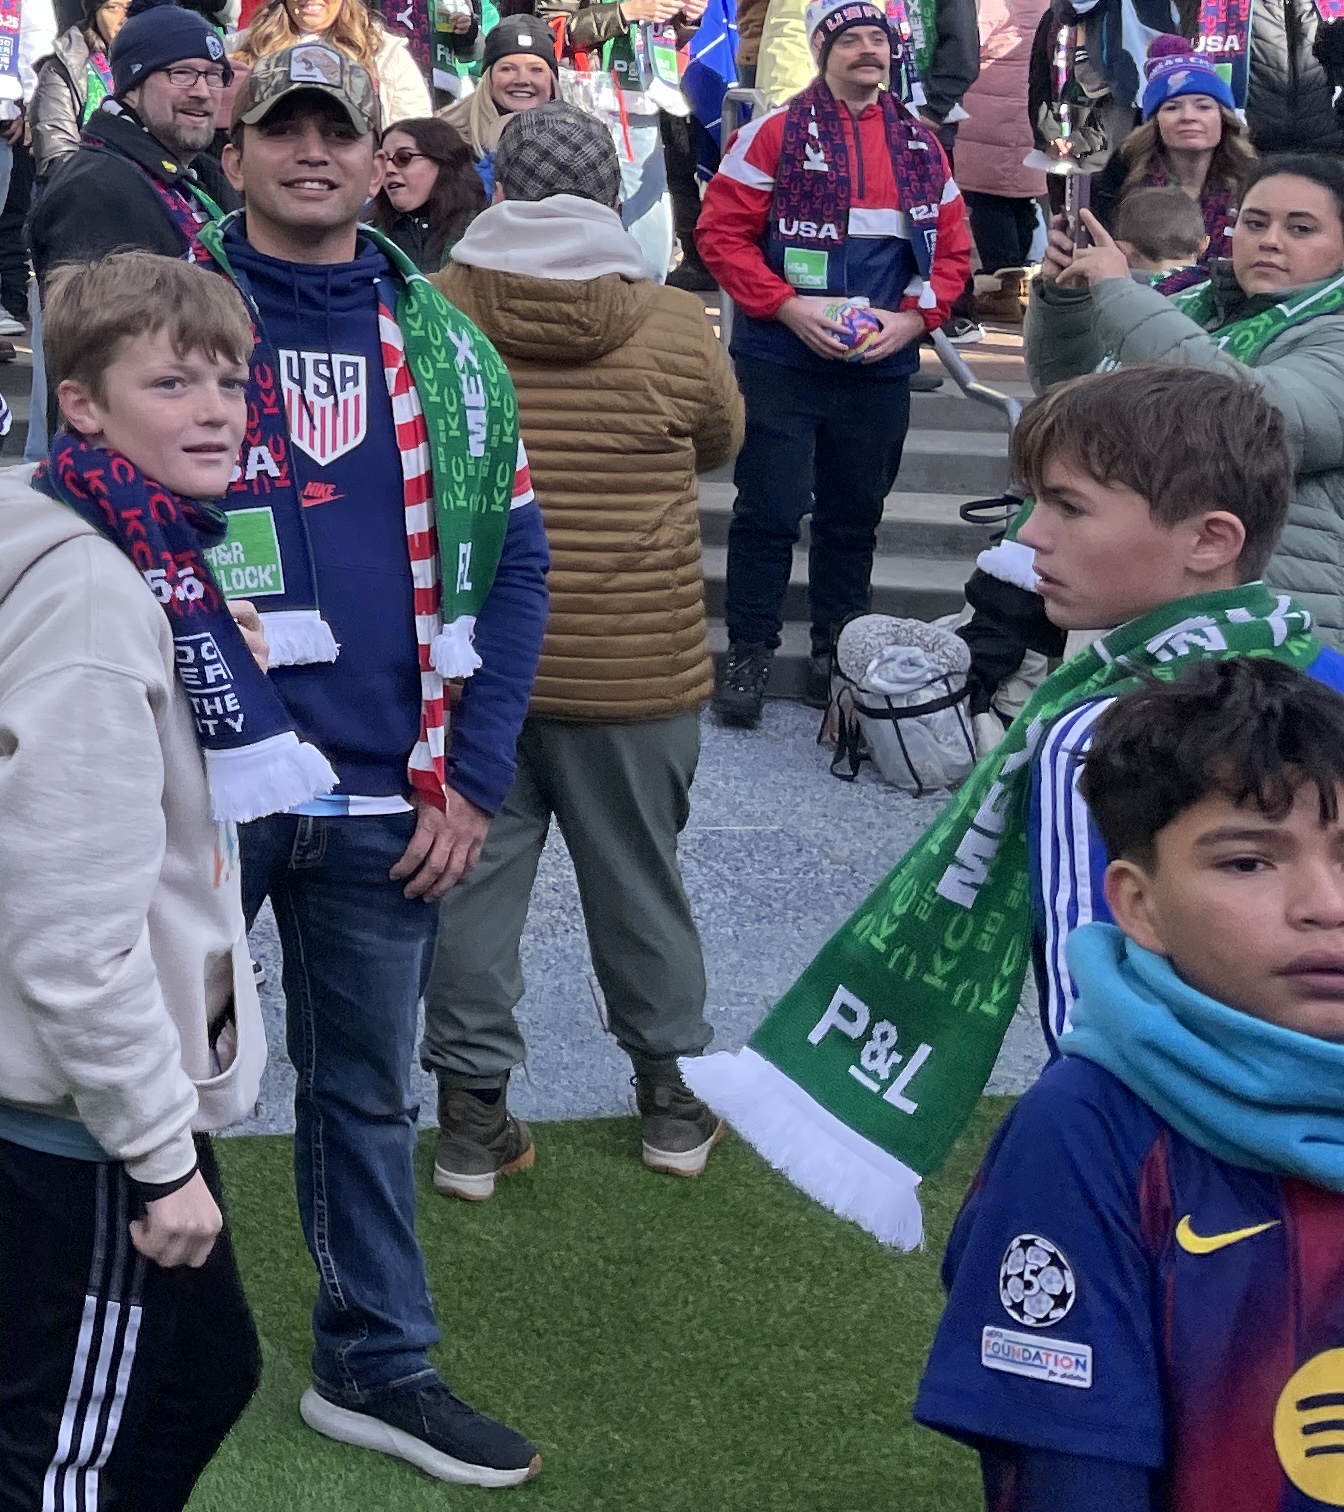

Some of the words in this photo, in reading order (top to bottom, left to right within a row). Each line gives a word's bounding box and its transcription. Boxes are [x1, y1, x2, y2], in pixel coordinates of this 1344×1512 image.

[778, 217, 838, 240] USA
[281, 351, 366, 400] USA
[445, 327, 486, 458] MEX
[303, 483, 337, 500] NIKE
[180, 667, 227, 687] ER
[807, 984, 933, 1115] P&L
[1021, 1262, 1040, 1295] 5
[983, 1339, 1088, 1373] FOUNDATION
